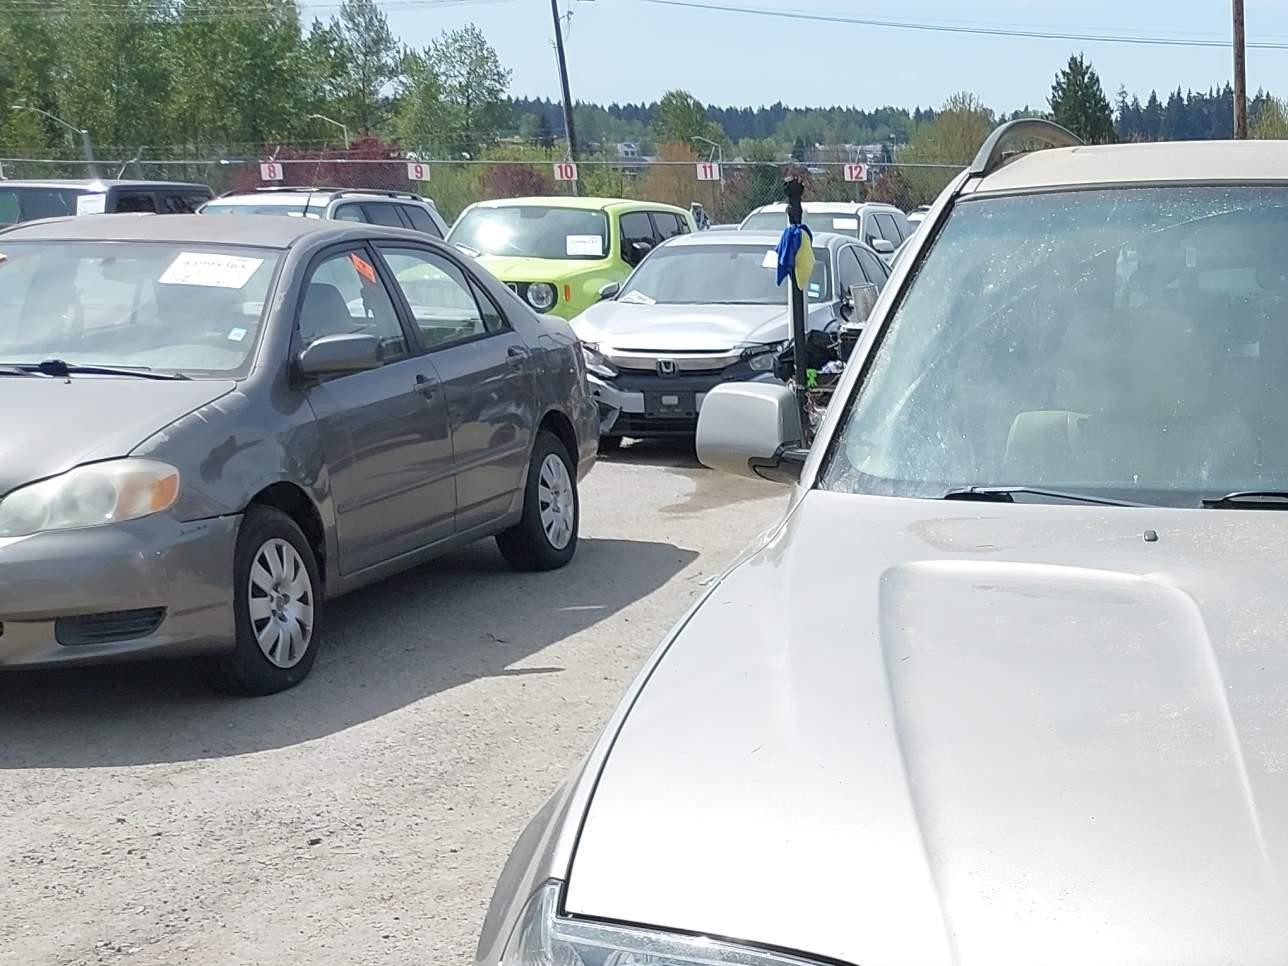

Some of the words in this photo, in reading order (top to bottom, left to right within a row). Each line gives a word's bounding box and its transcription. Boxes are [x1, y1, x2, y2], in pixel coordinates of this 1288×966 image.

[268, 164, 276, 179] 8
[415, 165, 424, 178] 9
[558, 164, 574, 178] 10
[702, 165, 714, 179] 11
[848, 165, 864, 180] 12
